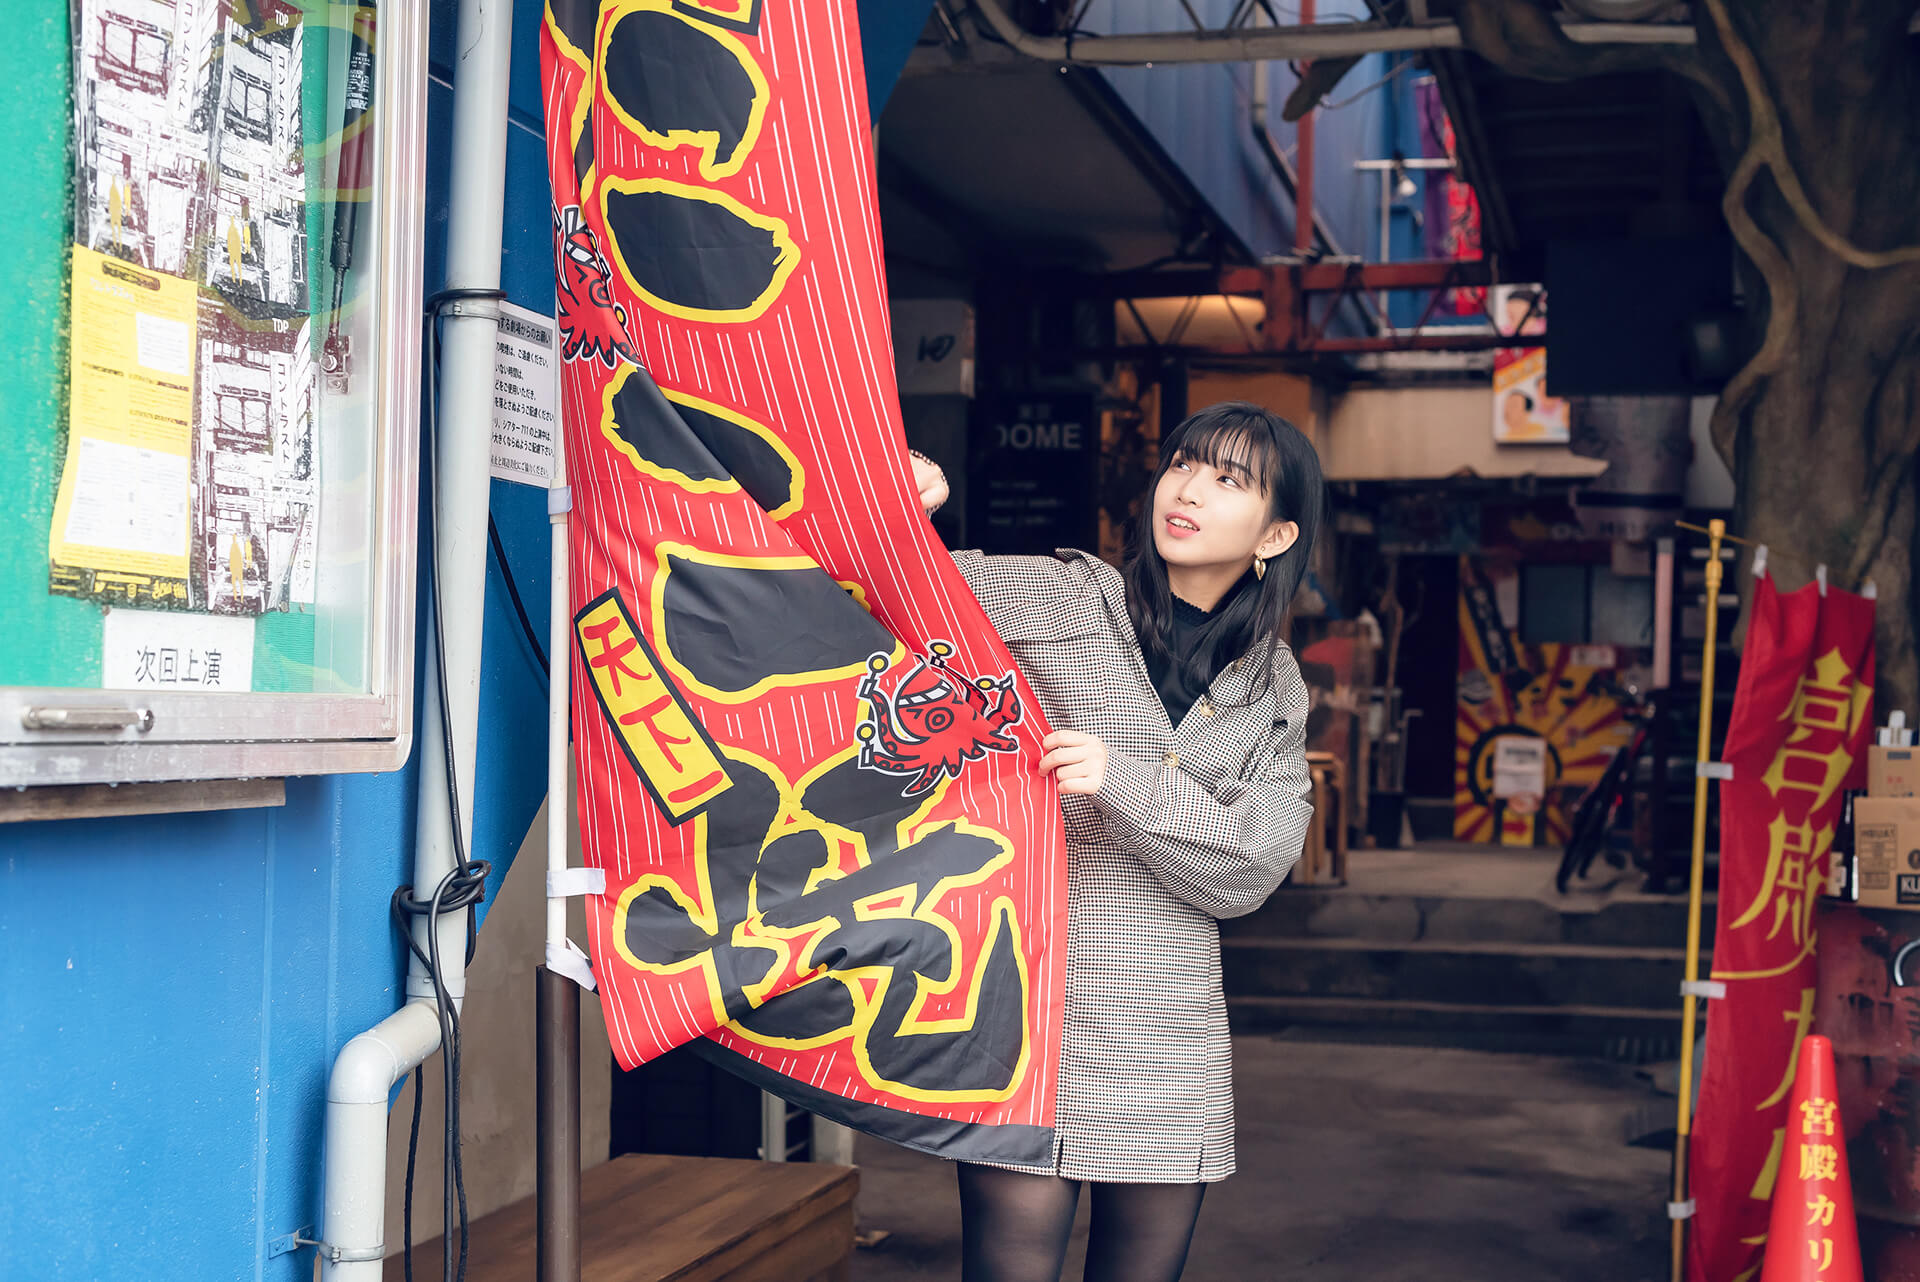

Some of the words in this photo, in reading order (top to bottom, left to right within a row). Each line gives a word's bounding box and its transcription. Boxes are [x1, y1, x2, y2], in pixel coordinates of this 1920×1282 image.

[276, 56, 287, 154] コントラスト
[277, 362, 290, 465] コントラスト
[135, 645, 223, 686] 次回上演
[583, 615, 725, 804] 天下一
[1798, 1096, 1839, 1282] 宮殿カリ
